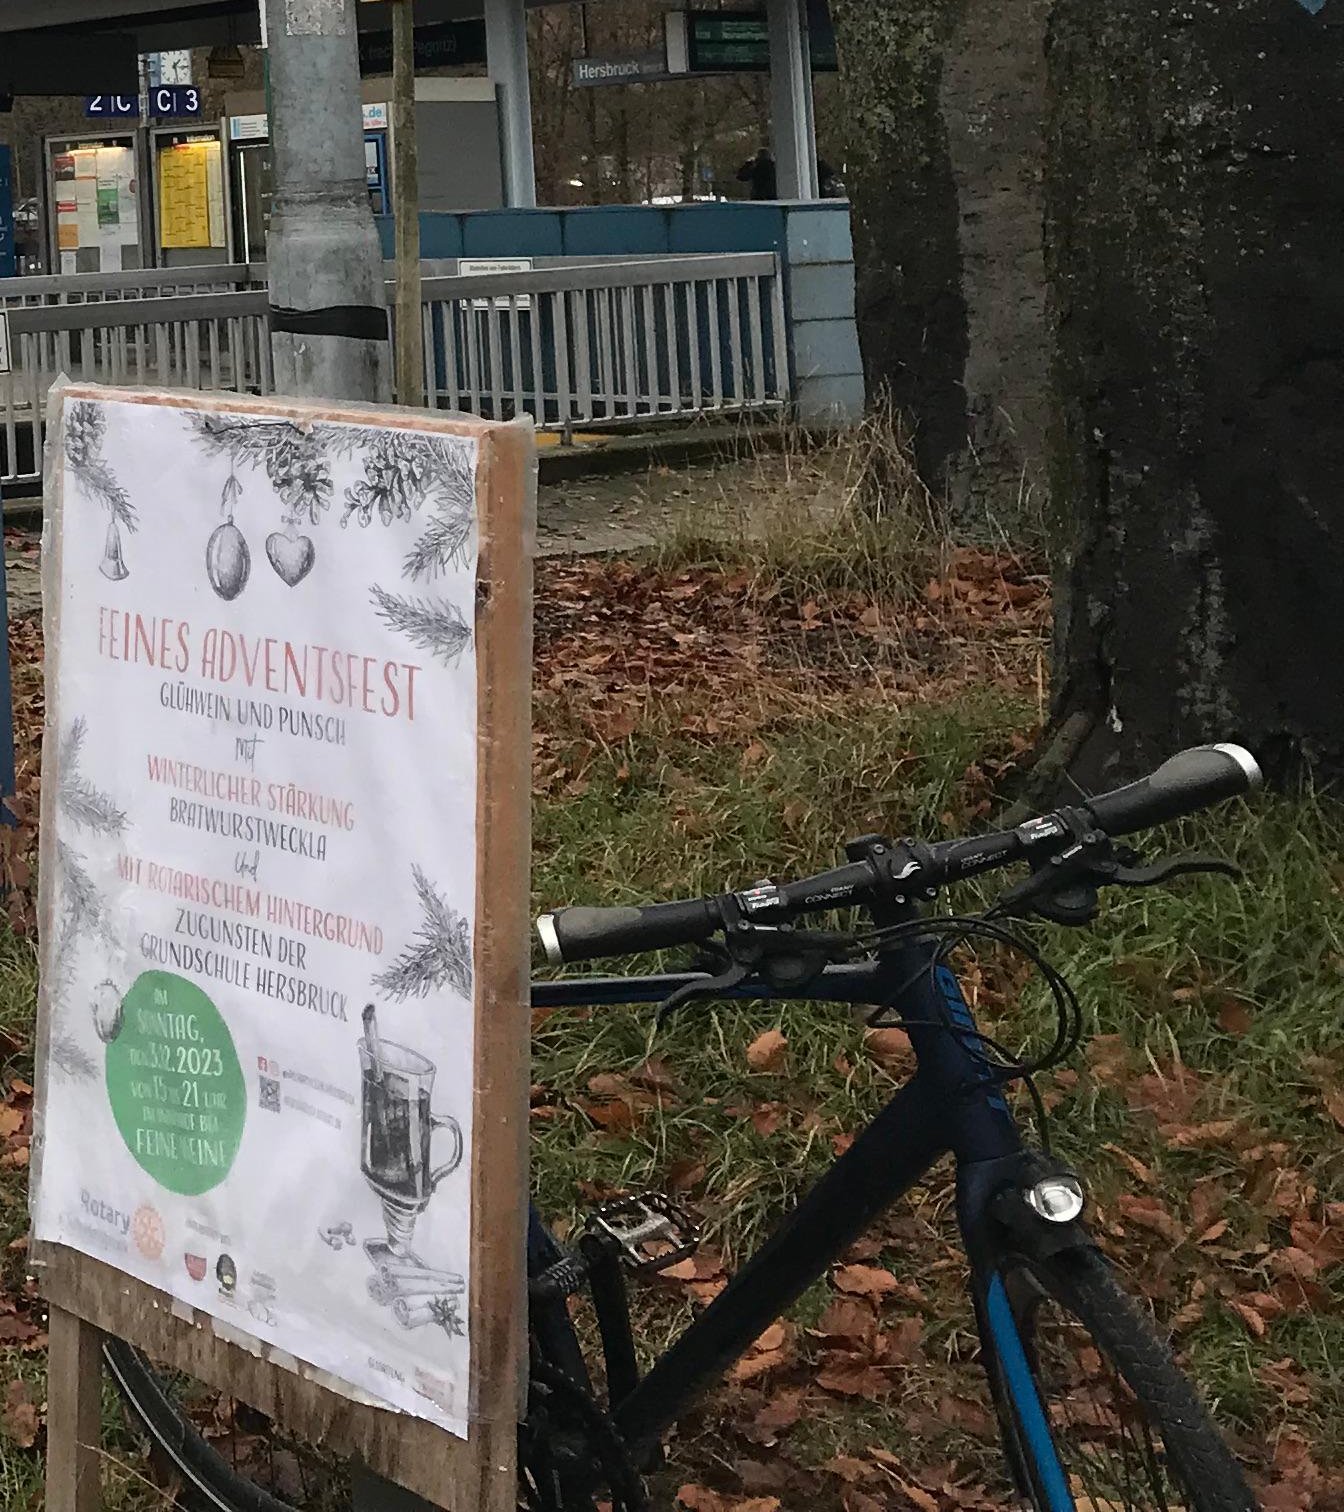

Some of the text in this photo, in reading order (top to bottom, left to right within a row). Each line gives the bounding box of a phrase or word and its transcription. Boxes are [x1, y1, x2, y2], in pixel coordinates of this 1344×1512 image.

[157, 90, 198, 112] C 3
[579, 61, 639, 79] Hersbruck
[98, 606, 422, 721] FEINES ADVENTSFEST
[160, 680, 346, 747] GLÜHWEIN UND PUNSCH
[146, 754, 355, 831] WINTERLICHER STÄRKUNG
[169, 797, 326, 862] BRATWURSTWECKLA
[118, 854, 384, 955] MIT ROTARISCHEM HINTERGRUND
[175, 908, 306, 970] ZUGUNSTEN DER
[140, 933, 348, 1023] GRUNDSCHULE HERSBRUCK
[182, 1080, 199, 1108] 21
[80, 1189, 130, 1235] Rotary
